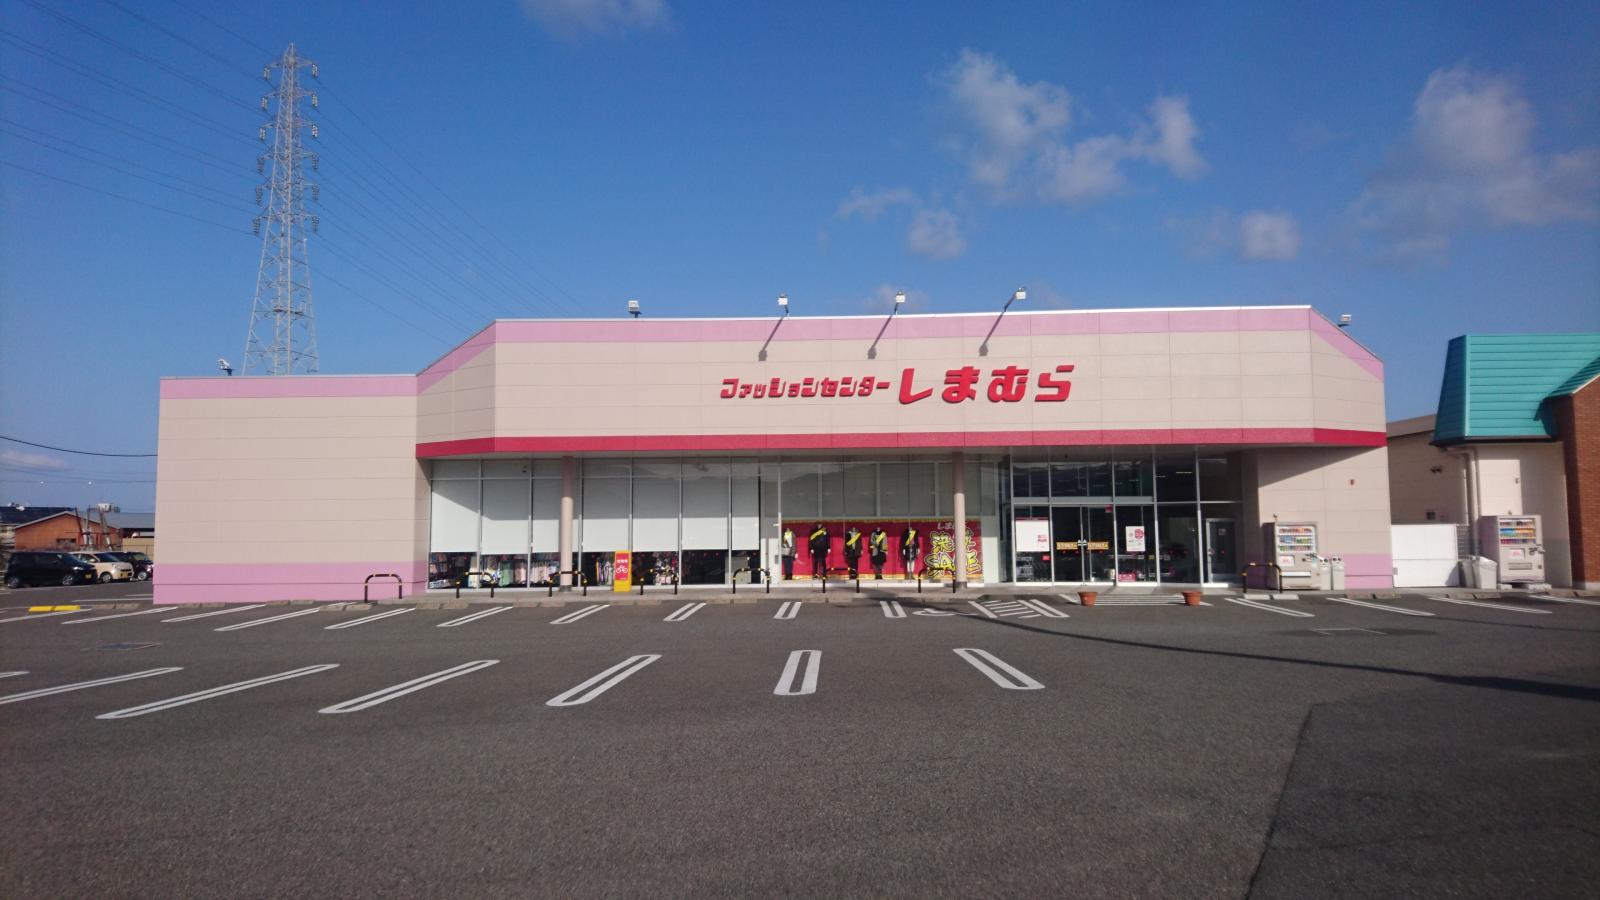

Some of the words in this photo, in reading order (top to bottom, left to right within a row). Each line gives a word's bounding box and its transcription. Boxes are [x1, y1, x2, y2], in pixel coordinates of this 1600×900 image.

[720, 378, 890, 399] ファッションセンター
[898, 365, 1075, 405] しまむら
[924, 551, 982, 577] SAE
